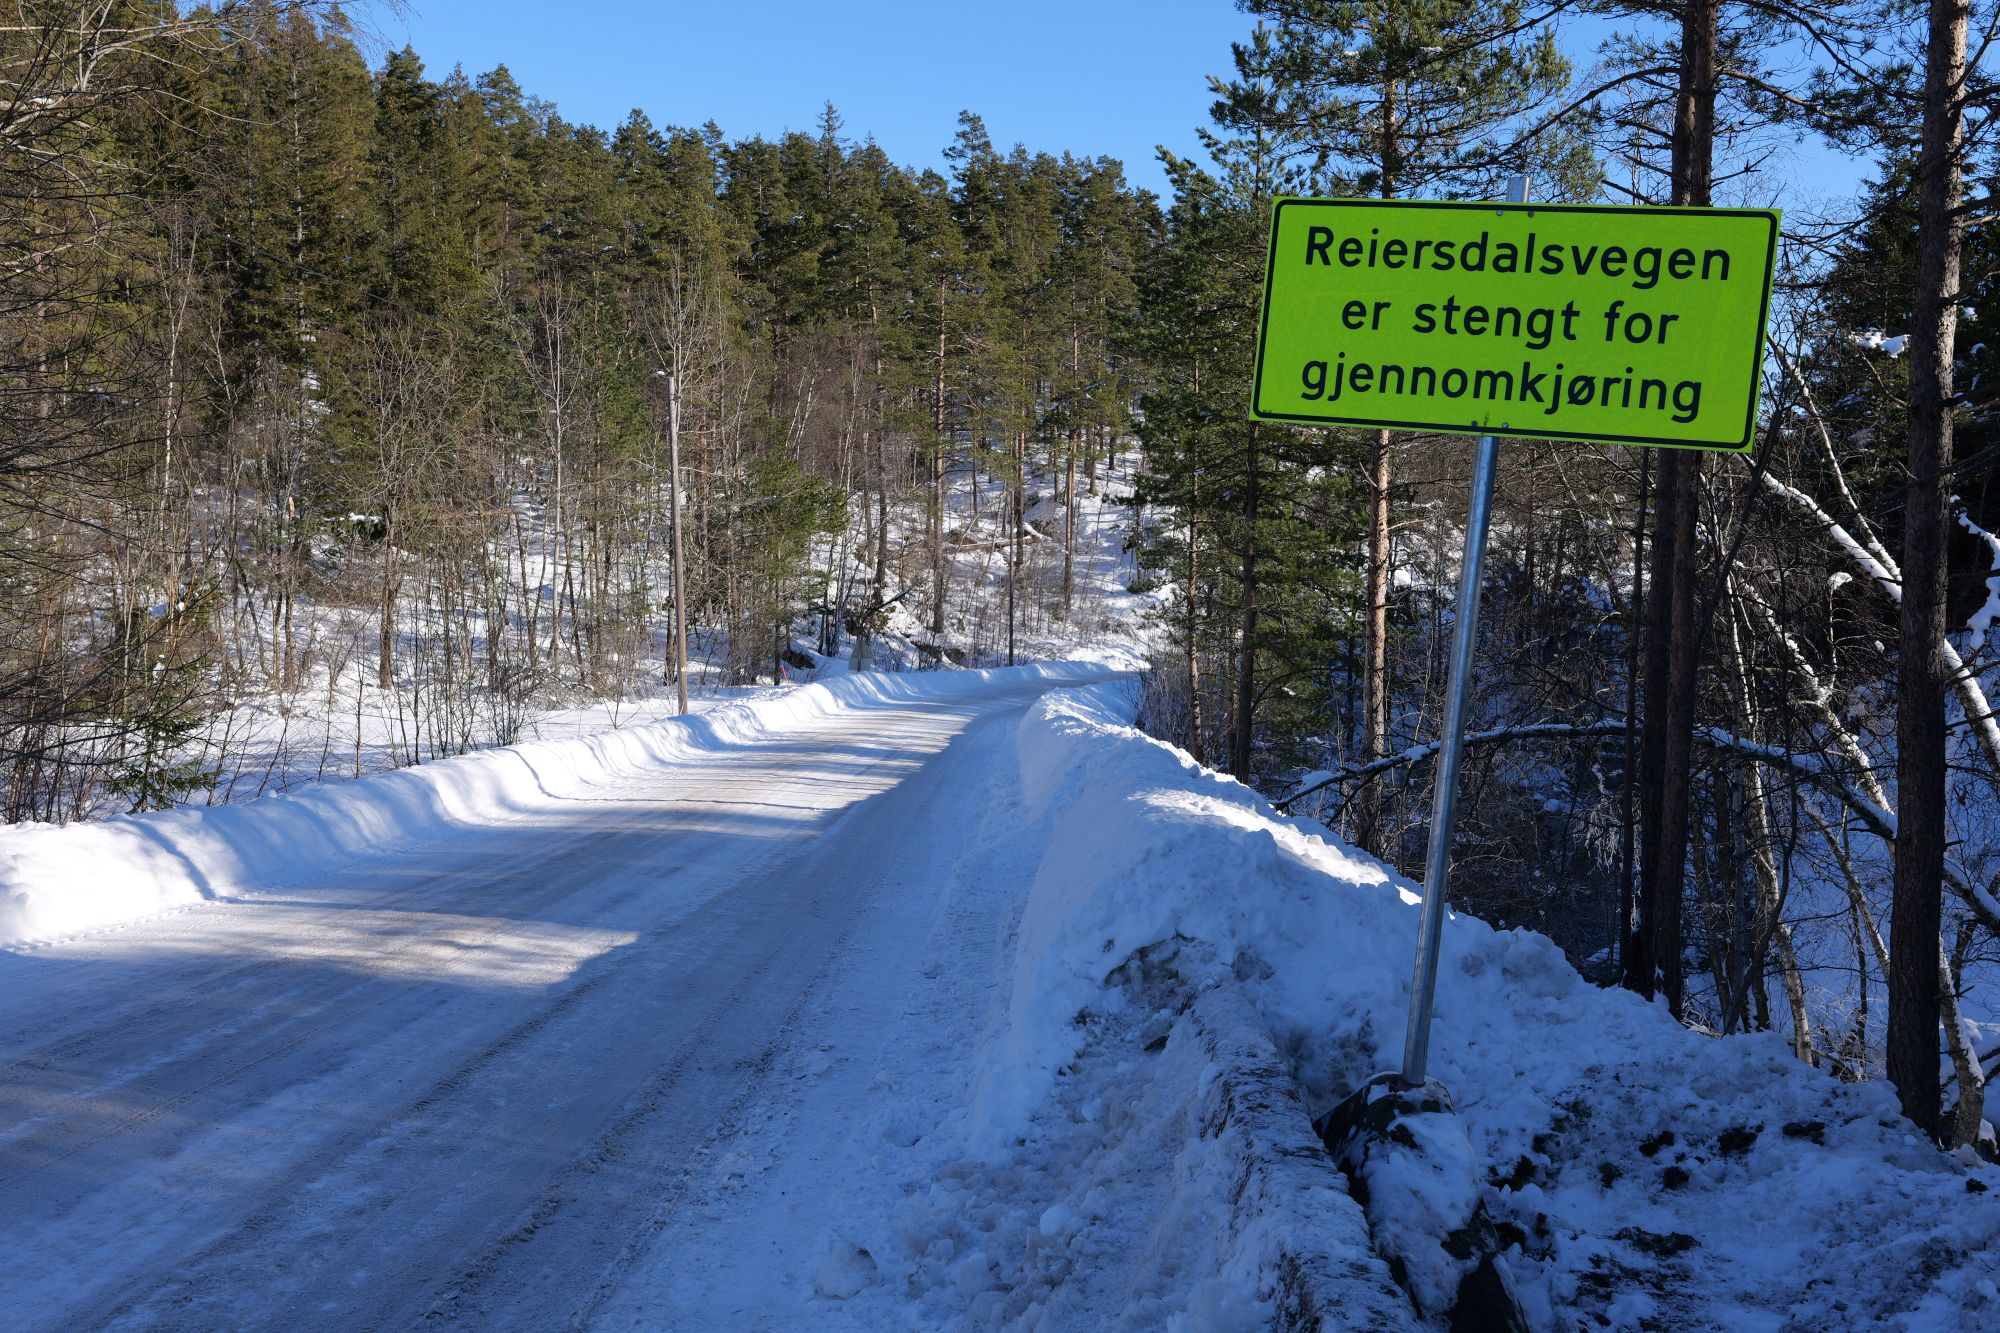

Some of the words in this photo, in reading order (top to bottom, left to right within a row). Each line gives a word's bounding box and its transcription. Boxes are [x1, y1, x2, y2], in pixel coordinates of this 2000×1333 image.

[1305, 226, 1731, 290] Reiersdalsvegen
[1341, 299, 1391, 331] er
[1412, 295, 1580, 350] stengt
[1604, 300, 1679, 344] for
[1300, 352, 1703, 424] gjennomkjøring
